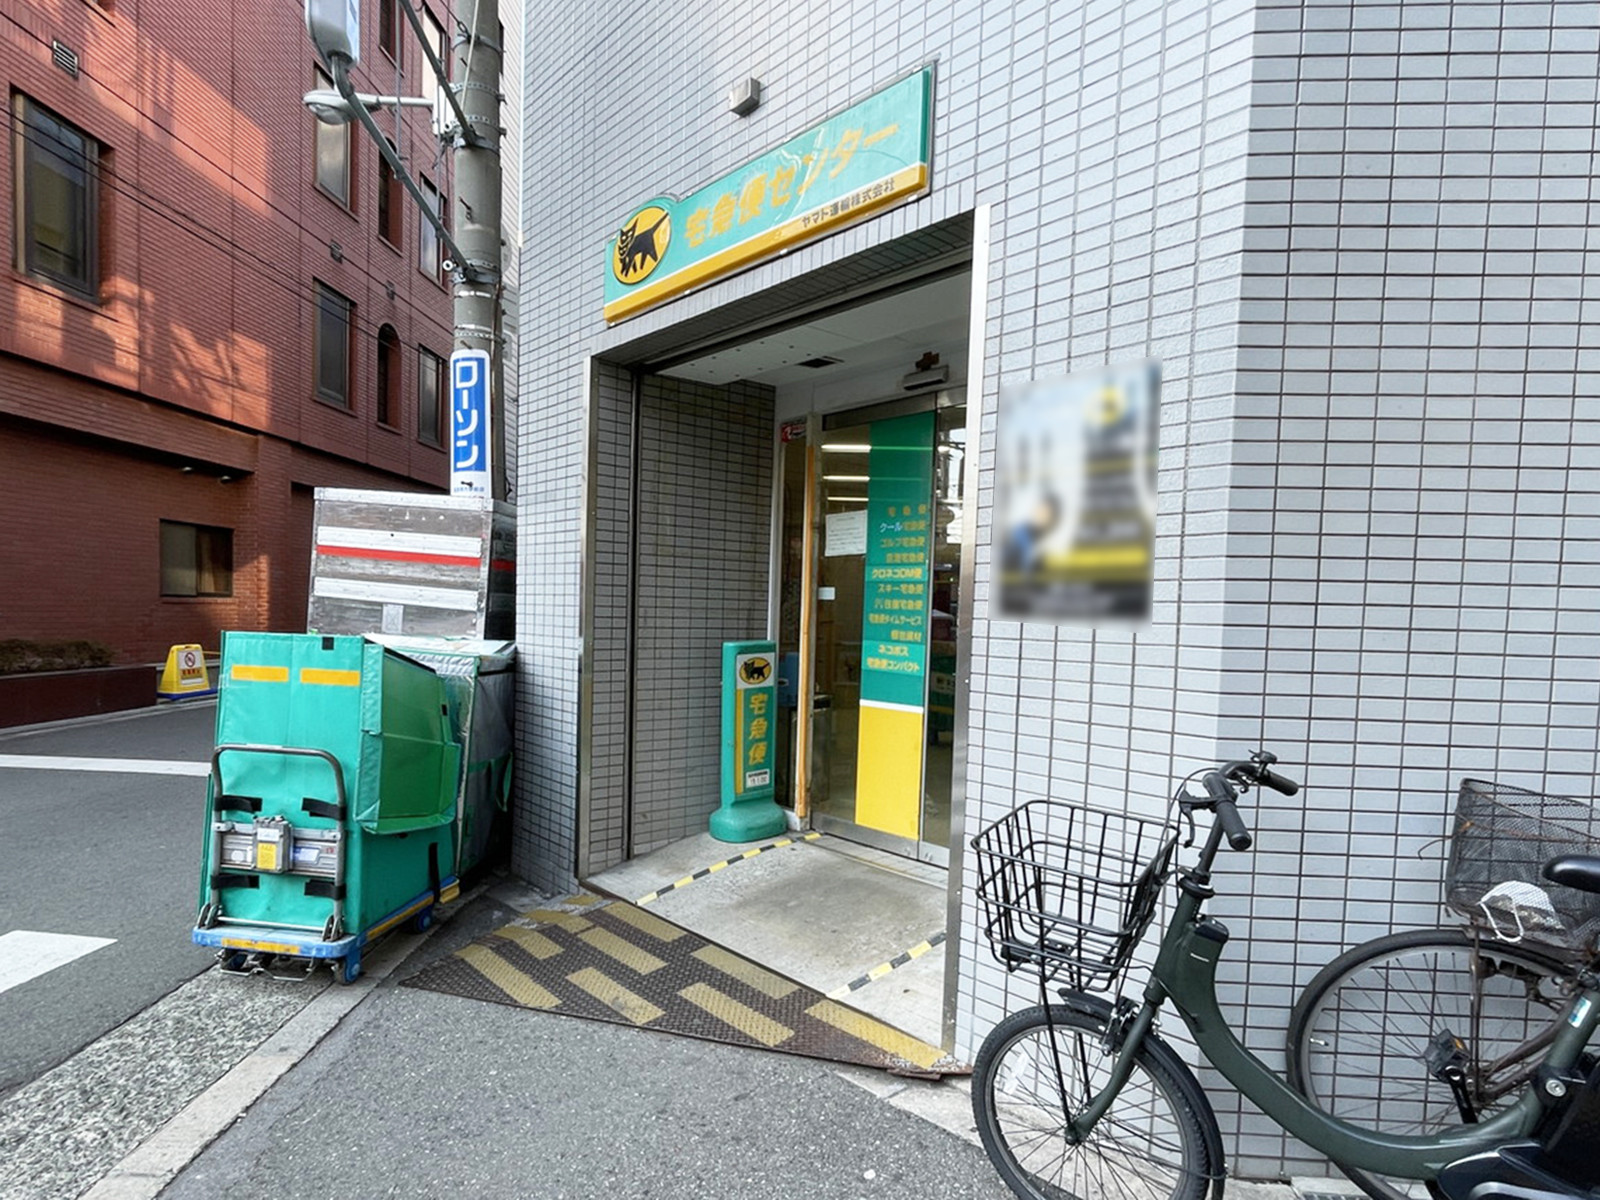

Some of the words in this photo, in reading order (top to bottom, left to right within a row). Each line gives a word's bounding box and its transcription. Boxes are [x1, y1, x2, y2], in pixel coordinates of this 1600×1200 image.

[685, 124, 899, 247] 宅急便センター
[802, 178, 894, 227] ヤマト運式会社
[456, 361, 478, 468] ローソン
[880, 521, 925, 533] クール
[872, 568, 922, 579] クロネコDM
[878, 583, 923, 595] スキー宅
[869, 613, 921, 626] タイムサービス
[867, 657, 920, 672] コンパクト
[749, 693, 768, 765] 宅急便
